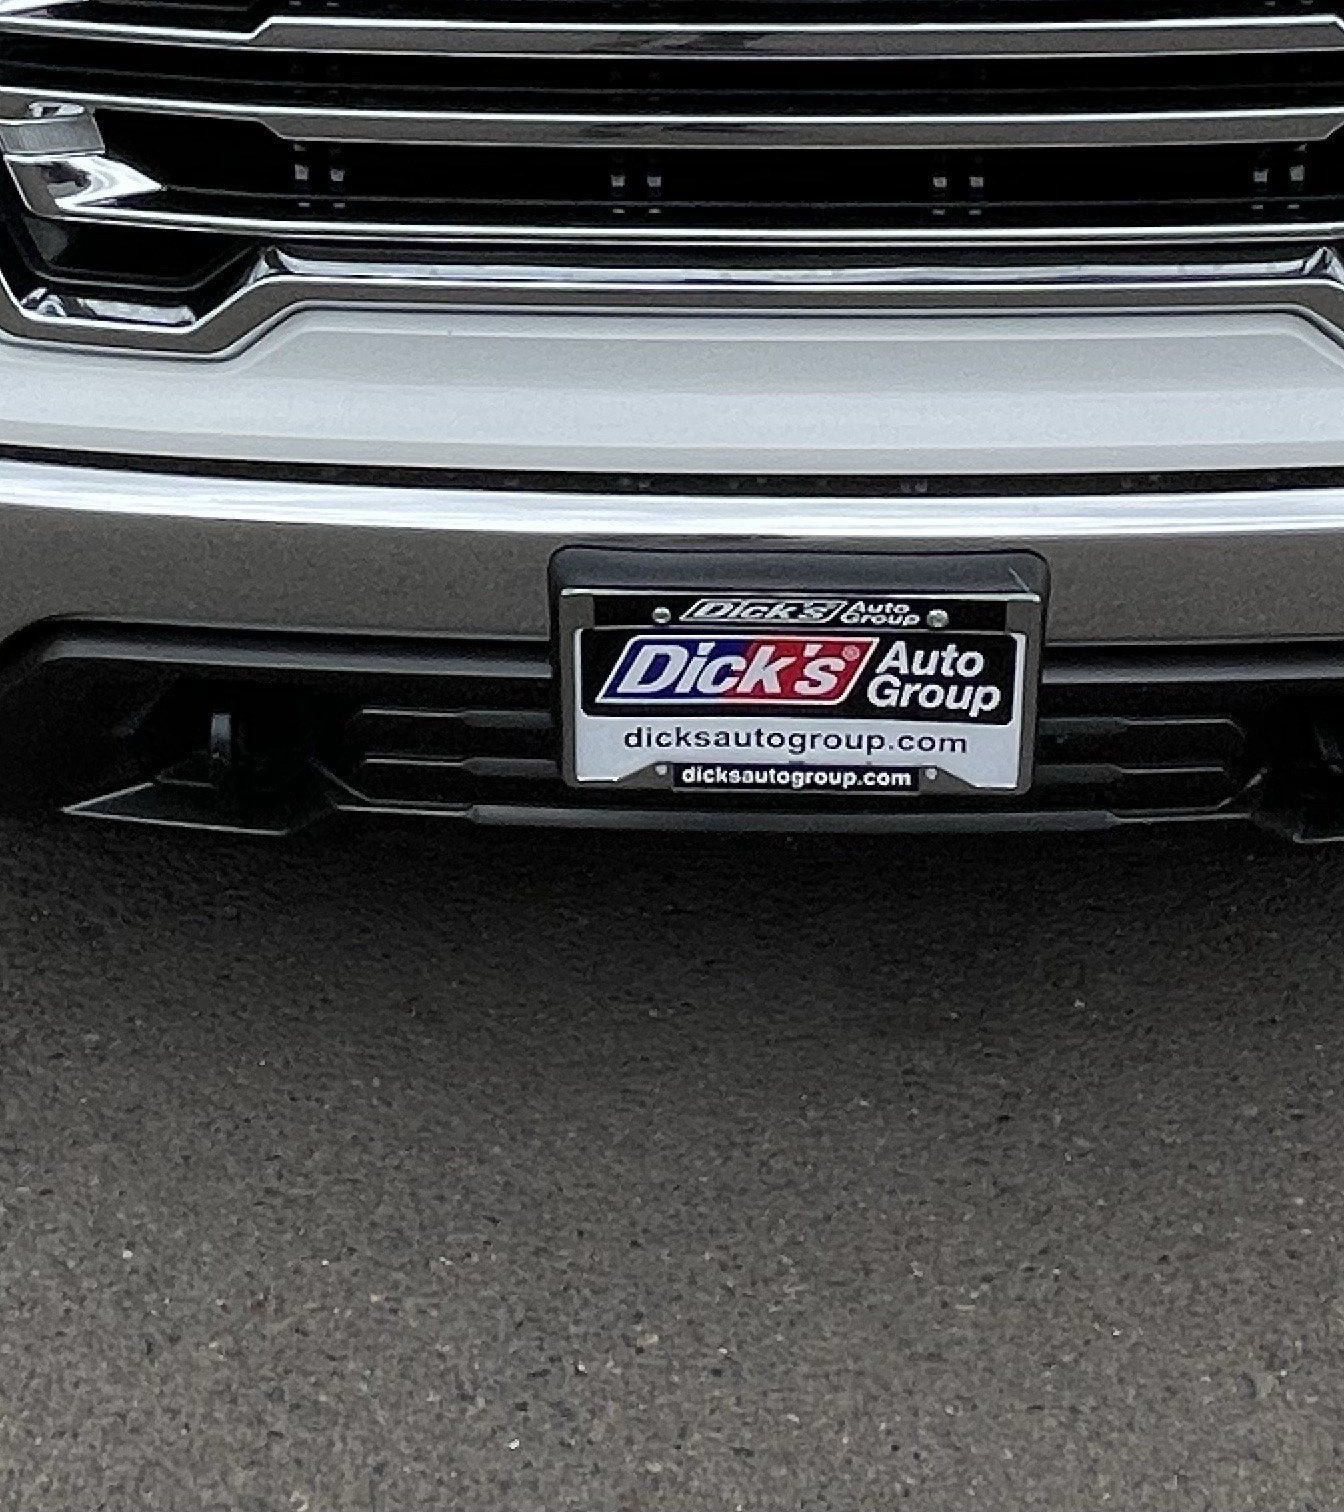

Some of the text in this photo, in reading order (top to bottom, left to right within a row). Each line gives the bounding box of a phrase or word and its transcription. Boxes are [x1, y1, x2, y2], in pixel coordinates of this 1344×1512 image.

[840, 611, 920, 626] Group
[851, 600, 911, 615] Auto
[616, 642, 844, 696] Dick's
[875, 641, 985, 678] Auto
[866, 675, 1002, 718] Group
[623, 727, 968, 755] dicksautogroup.com
[681, 766, 912, 789] dicksautogroup.com
